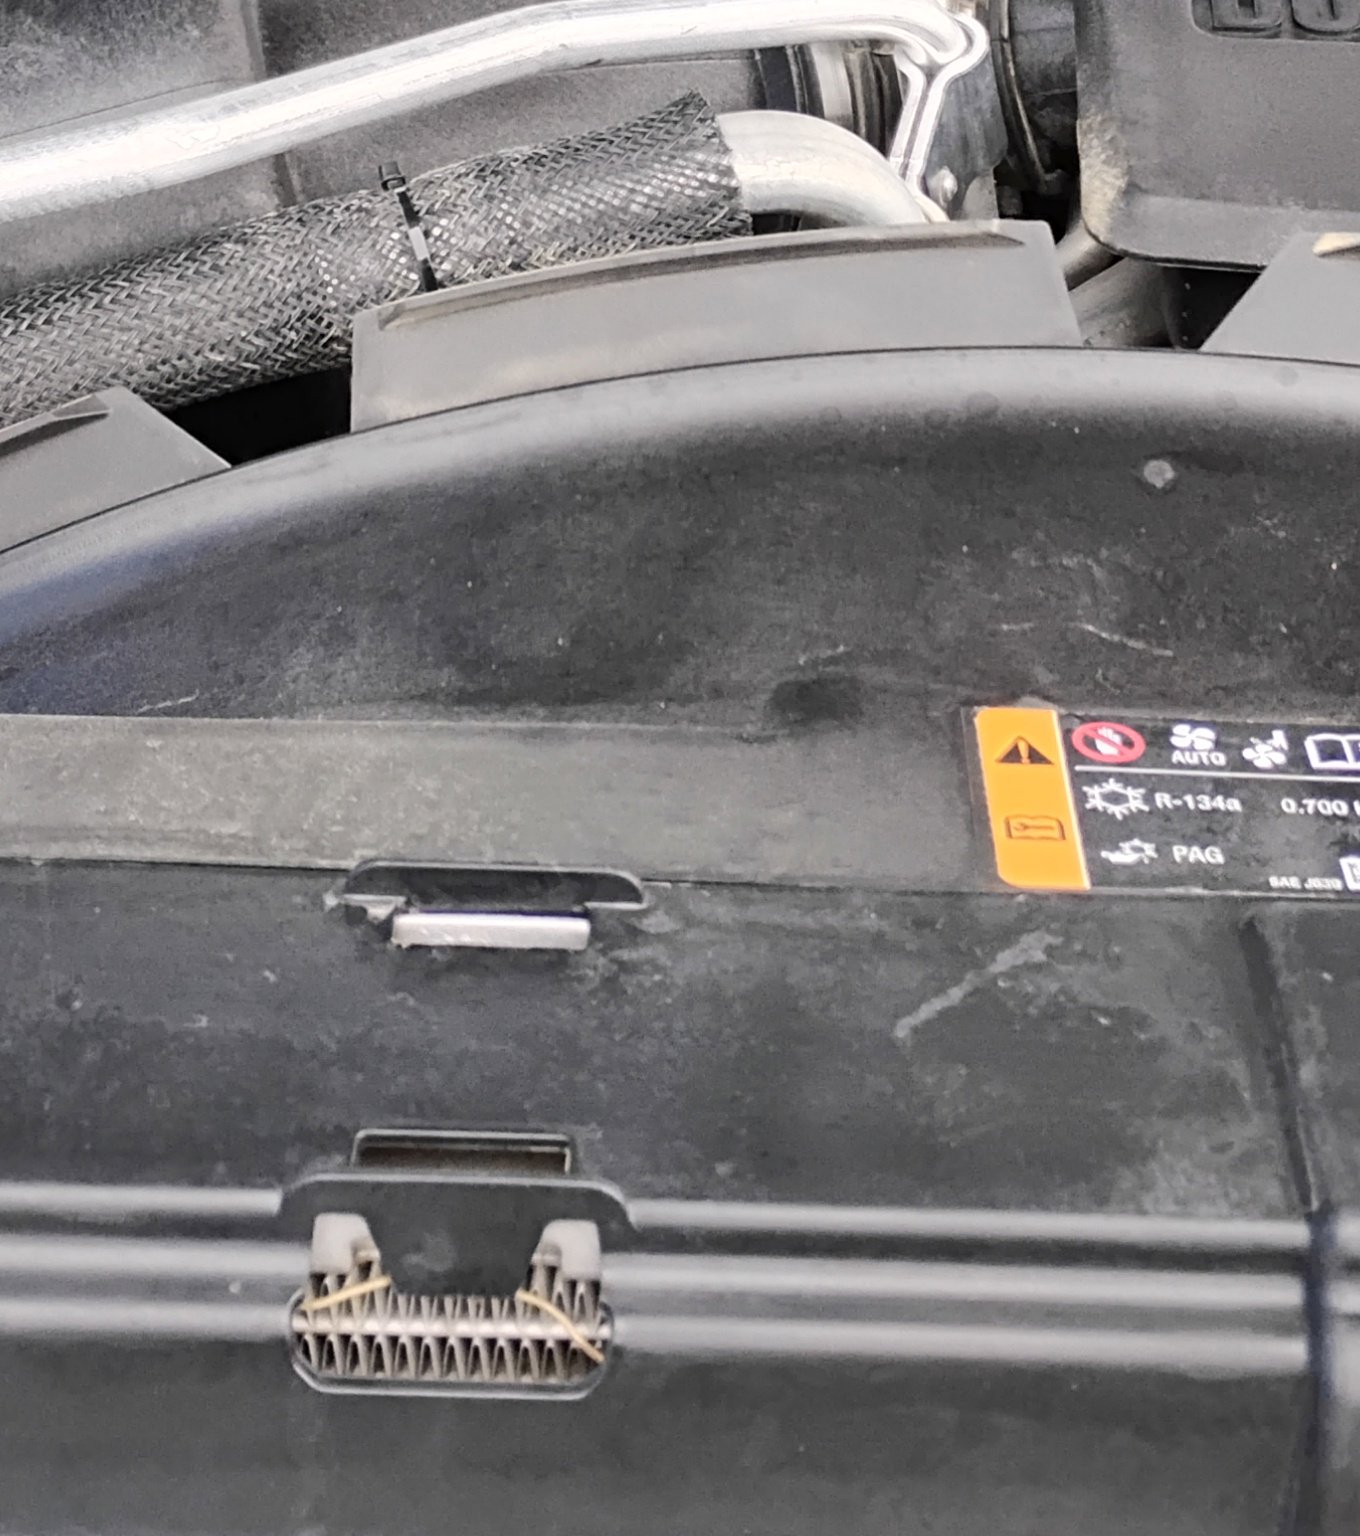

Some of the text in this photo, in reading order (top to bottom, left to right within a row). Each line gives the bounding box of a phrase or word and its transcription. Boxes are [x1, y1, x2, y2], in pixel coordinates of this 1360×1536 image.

[1171, 748, 1226, 766] AUTO
[1155, 791, 1242, 814] R-134a
[1281, 796, 1347, 817] 0.700
[1173, 845, 1224, 865] PAG
[1269, 875, 1301, 889] SAE
